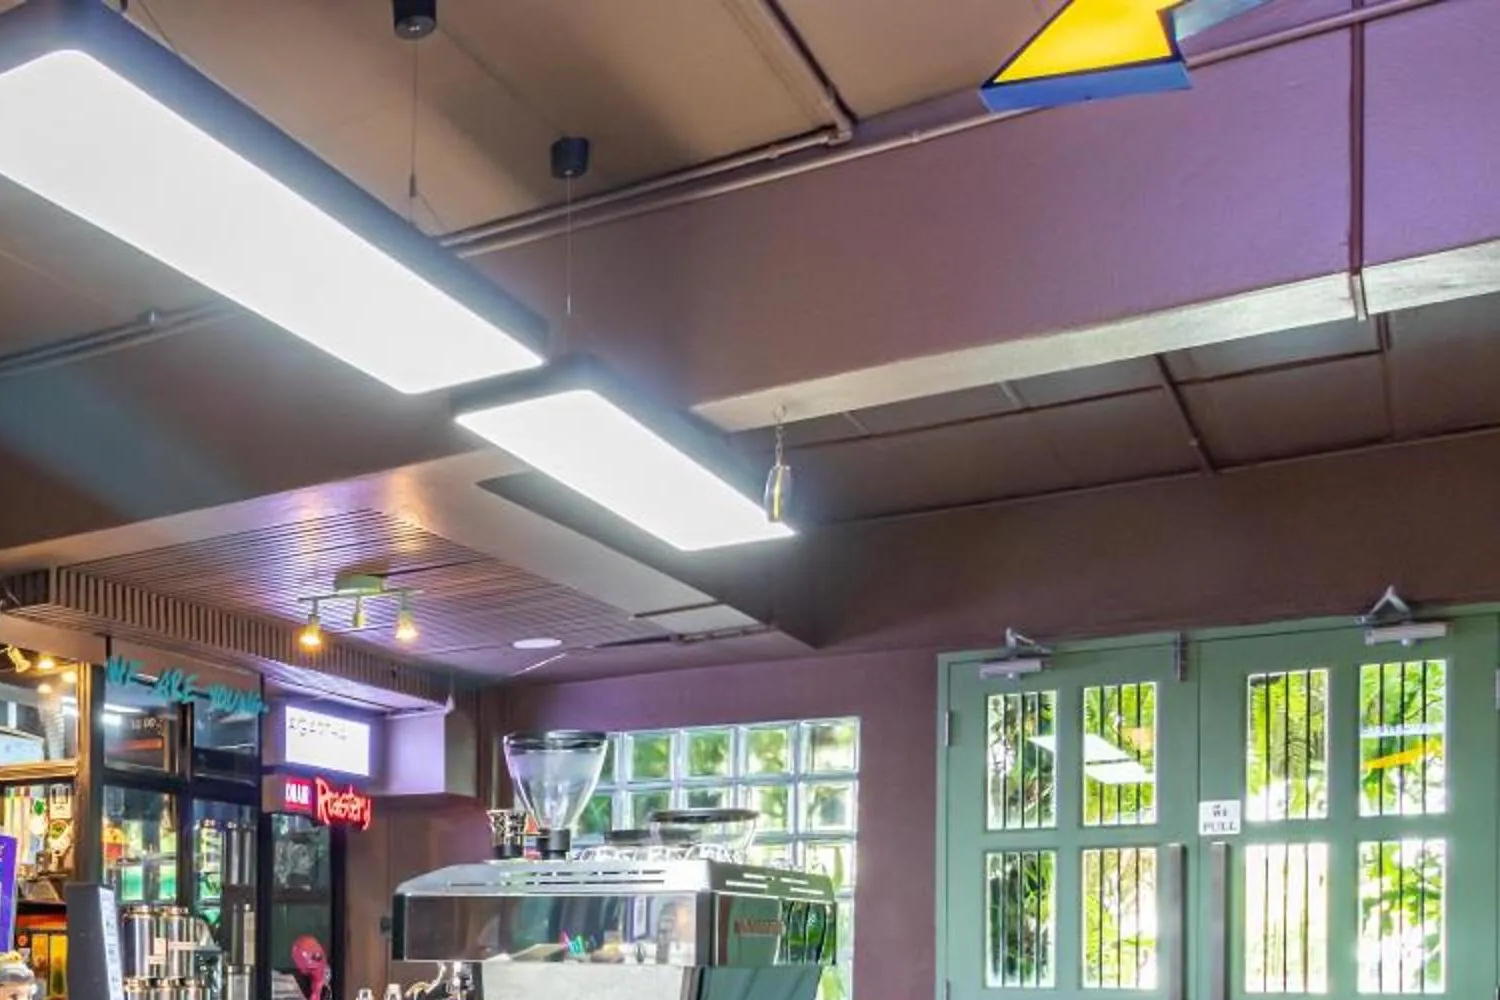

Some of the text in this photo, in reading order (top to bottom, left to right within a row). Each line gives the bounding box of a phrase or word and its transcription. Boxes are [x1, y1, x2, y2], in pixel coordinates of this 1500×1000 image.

[106, 656, 145, 686] WE
[152, 667, 199, 703] ARE
[315, 776, 371, 831] Roastery
[1203, 821, 1238, 832] PULL
